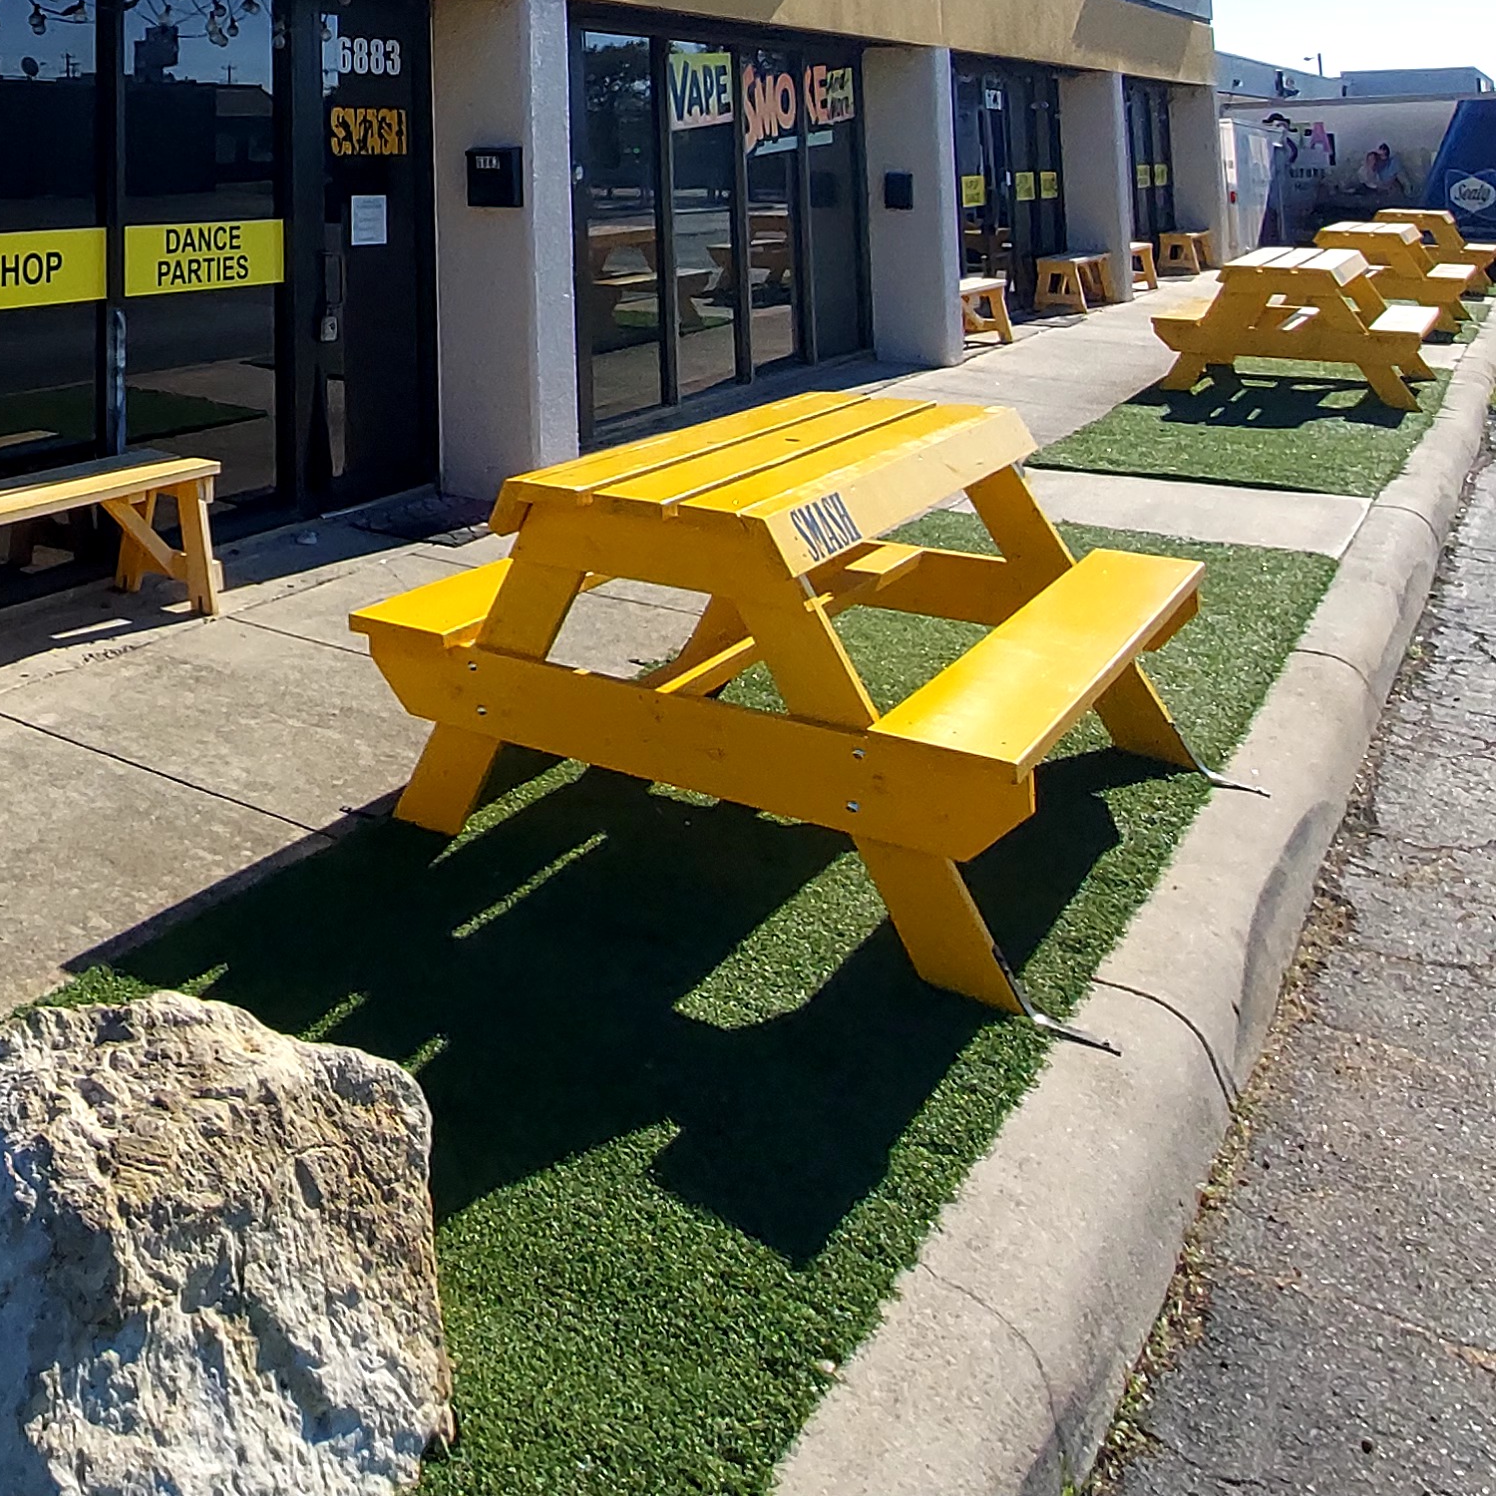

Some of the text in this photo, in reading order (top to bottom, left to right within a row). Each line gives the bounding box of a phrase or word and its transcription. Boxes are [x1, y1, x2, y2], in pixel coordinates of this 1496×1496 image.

[338, 36, 401, 75] 6883
[669, 60, 731, 122] VAPE
[165, 225, 242, 254] DANCE
[1, 252, 62, 287] HOP
[157, 254, 249, 286] PARTIES
[790, 492, 862, 562] SMASH
